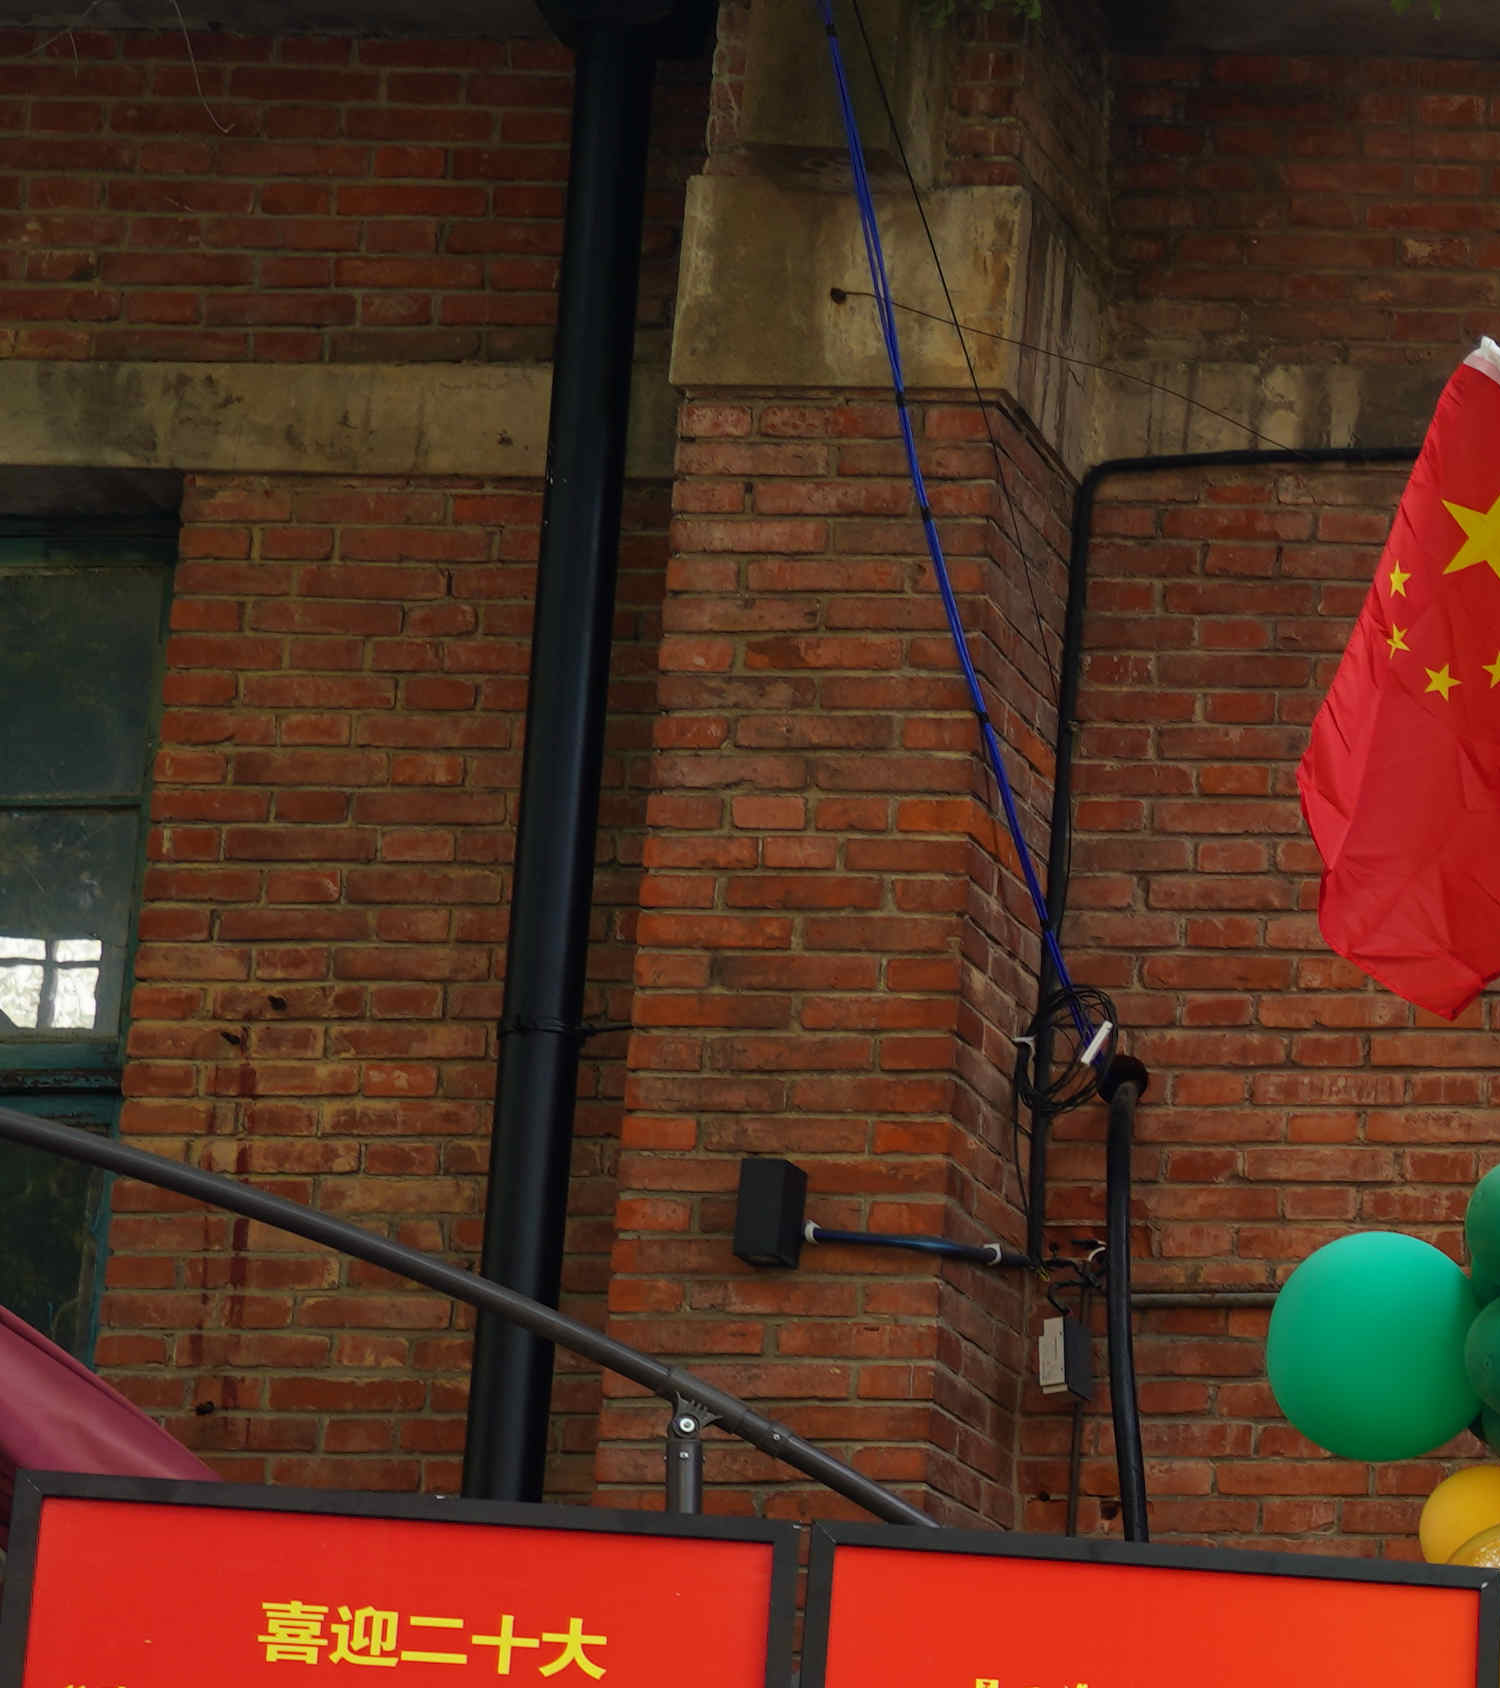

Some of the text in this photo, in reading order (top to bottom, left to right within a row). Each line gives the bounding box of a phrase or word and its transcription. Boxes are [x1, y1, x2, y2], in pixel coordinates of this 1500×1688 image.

[257, 1599, 608, 1680] 喜迎二十大
